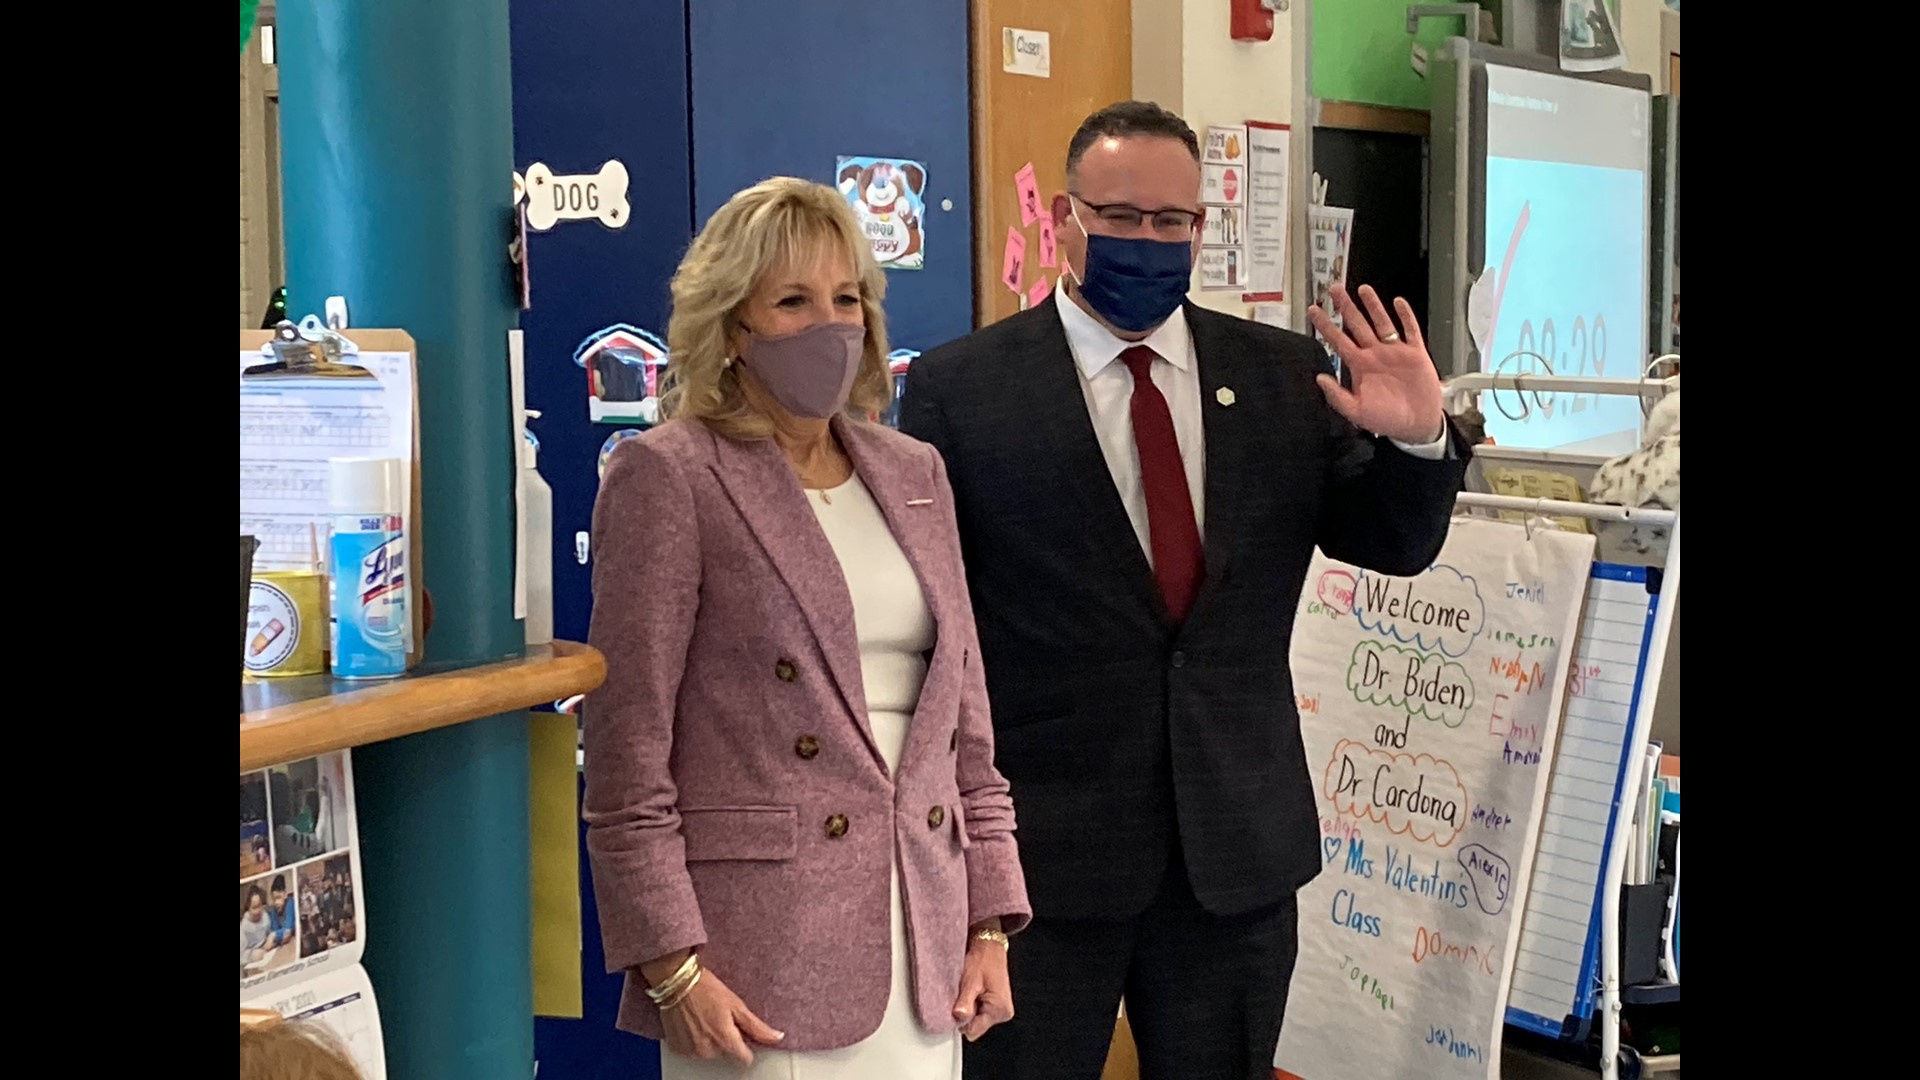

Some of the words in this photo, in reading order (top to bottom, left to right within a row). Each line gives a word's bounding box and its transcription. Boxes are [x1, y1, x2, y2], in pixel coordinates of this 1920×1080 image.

[553, 182, 599, 211] DOG
[1366, 575, 1470, 633] Welcome
[1404, 656, 1466, 710] Biden
[1374, 714, 1411, 749] and
[1337, 753, 1363, 797] Dr
[1372, 763, 1457, 828] Cardona
[1343, 837, 1375, 879] Mrs
[1384, 844, 1469, 909] Valentin's
[1331, 888, 1382, 938] Class
